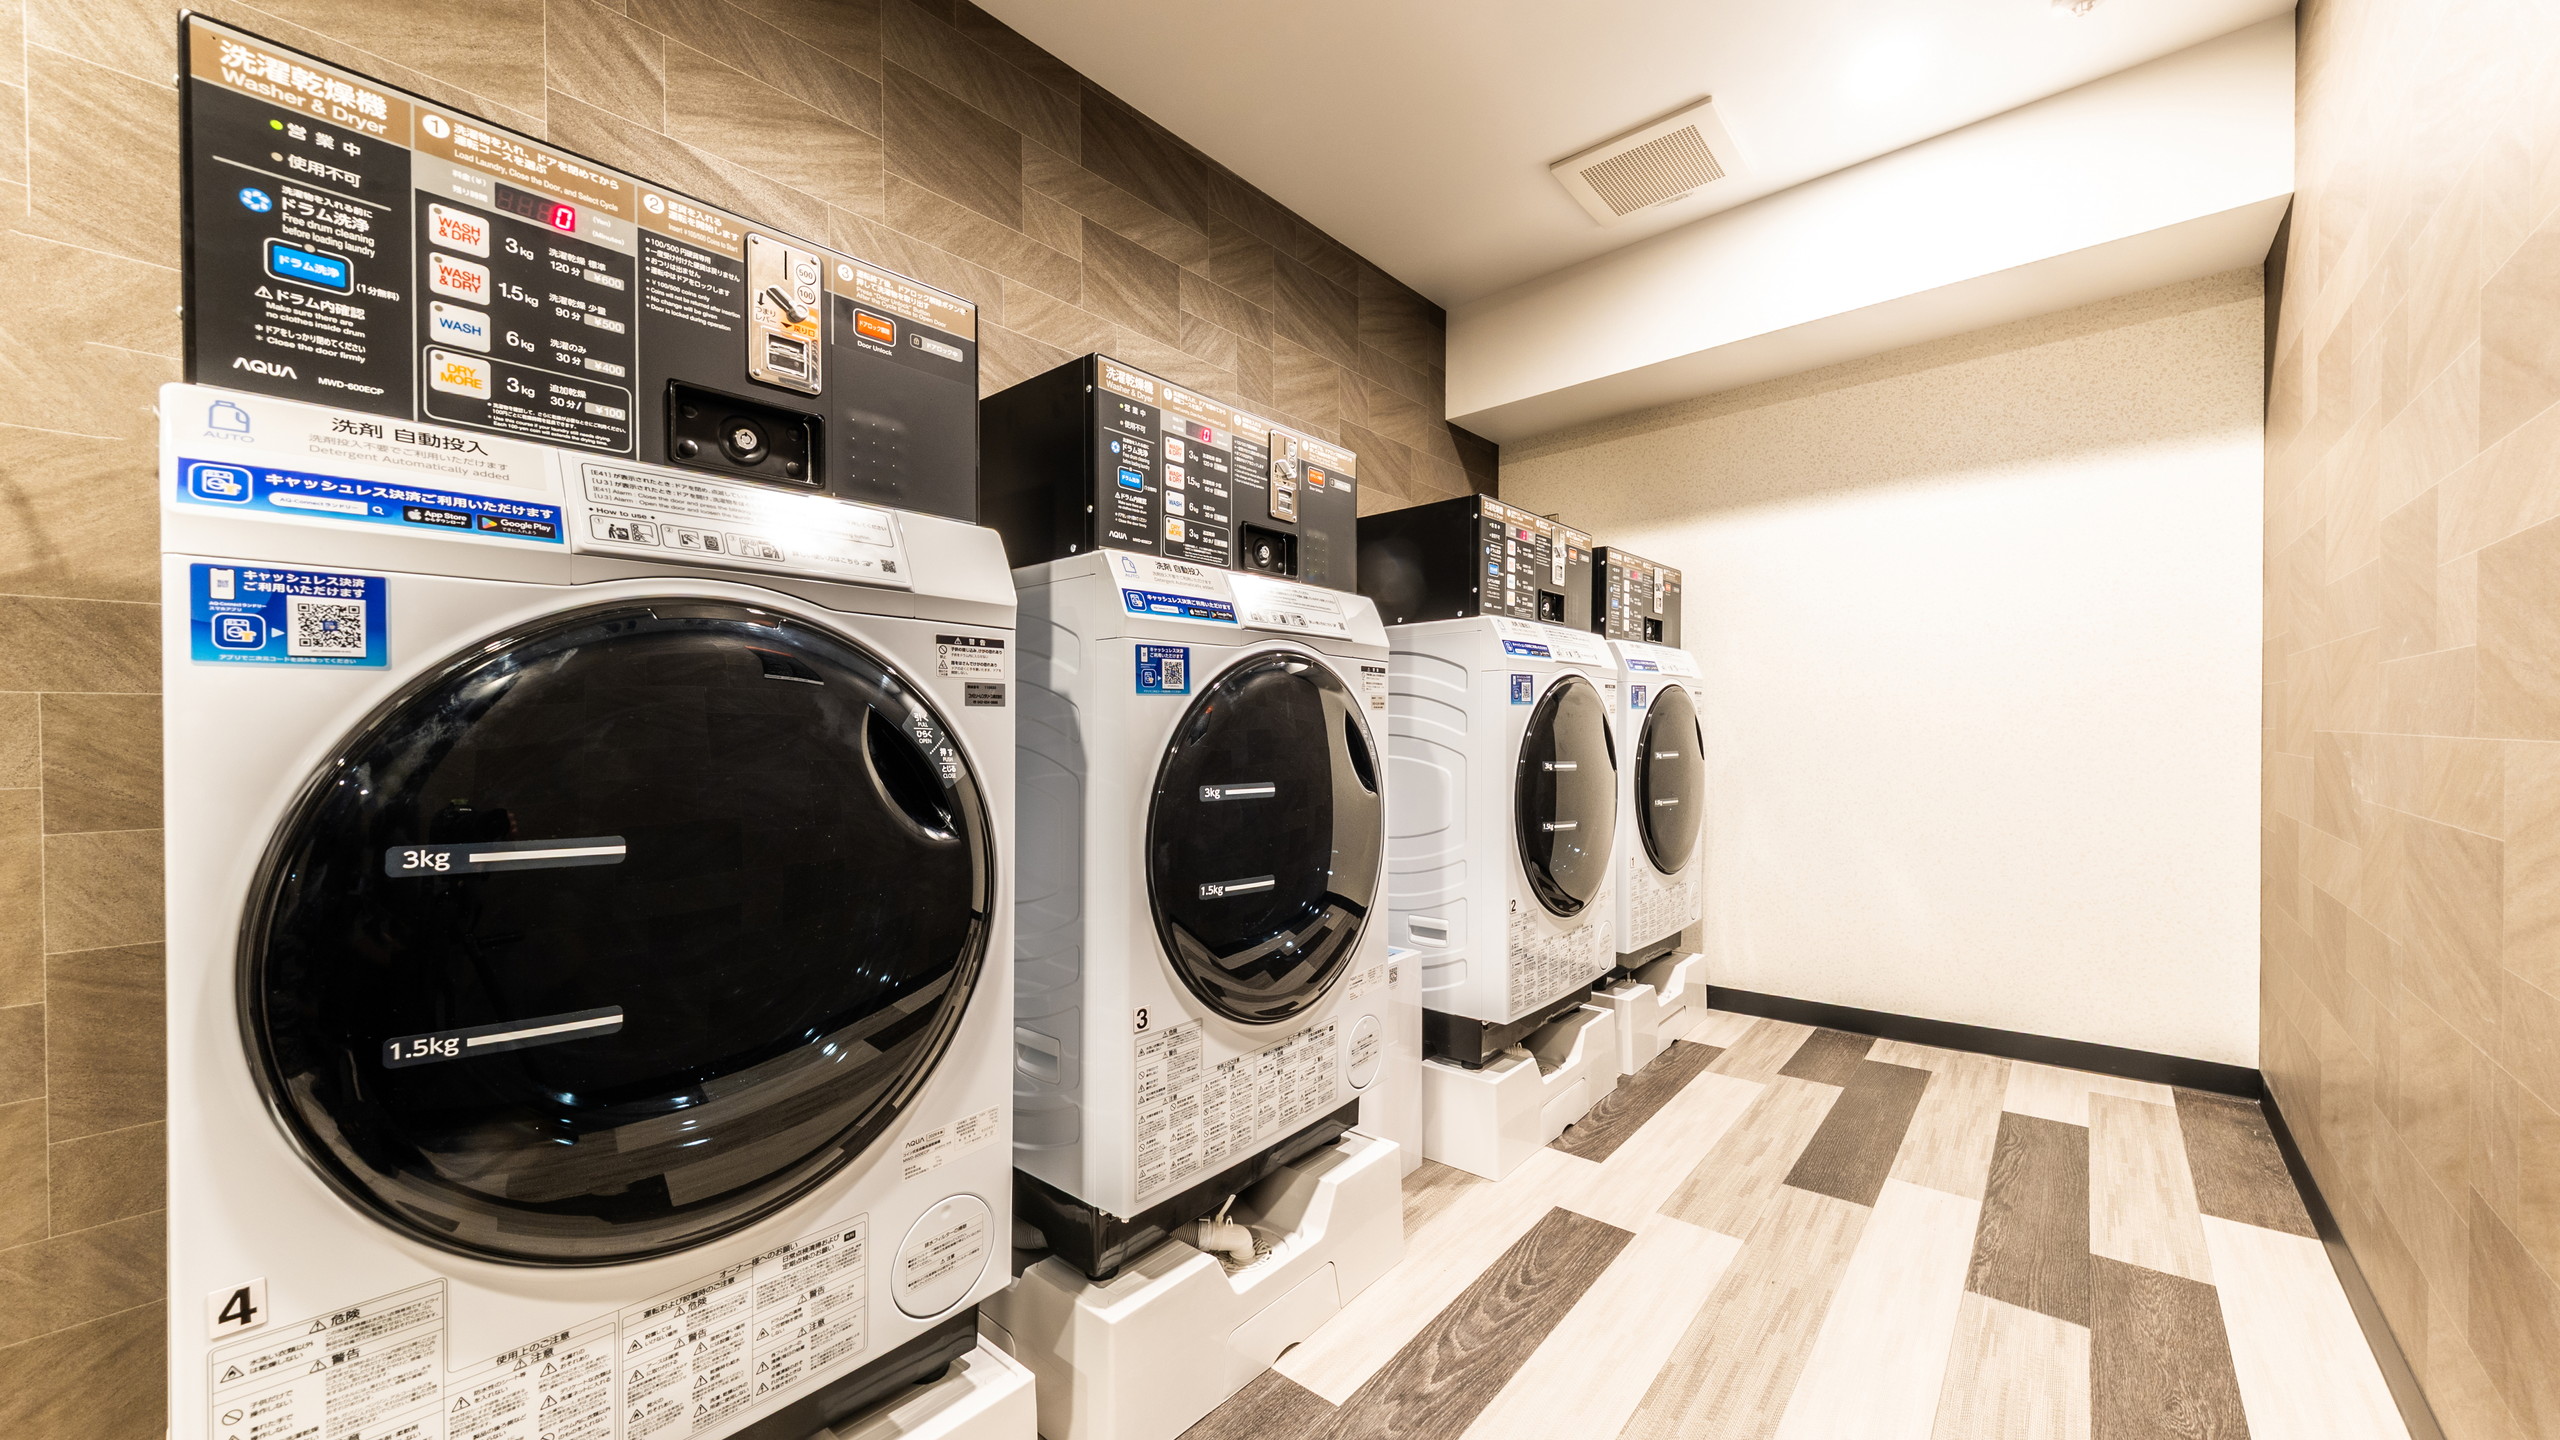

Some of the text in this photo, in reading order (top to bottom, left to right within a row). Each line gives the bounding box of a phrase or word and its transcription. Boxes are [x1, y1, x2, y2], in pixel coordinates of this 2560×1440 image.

[220, 40, 388, 120] 洗濯乾燥機
[221, 67, 388, 134] Washer & Dryer
[287, 122, 361, 157] 営業中
[453, 134, 548, 175] 運転コースを選ぶ
[287, 154, 361, 188] 使用不可
[454, 149, 619, 212] Load Laundry, Close the Door, and Select Cycle
[281, 185, 373, 218] 洗濯物を入れる前に
[282, 197, 370, 232] ドラム洗浄
[555, 207, 573, 230] 0
[667, 200, 722, 227] 硬貨を入れる
[282, 212, 375, 247] Free drum cleaning
[438, 216, 481, 237] WASH
[438, 226, 481, 246] & DRY
[668, 210, 740, 241] 運転を開始します
[282, 224, 375, 258] before loading laundry
[651, 238, 679, 253] 100/500
[279, 254, 340, 278] ドラム洗浄
[438, 264, 481, 285] WASH
[651, 258, 701, 279] おつりは出ません
[438, 275, 481, 294] & DRY
[593, 273, 622, 289] ¥600
[266, 301, 354, 328] Make sure there are
[276, 289, 366, 320] ドラム内確認
[651, 295, 660, 303] No
[661, 299, 683, 310] change
[683, 305, 693, 313] will
[702, 310, 718, 320] given
[755, 306, 777, 317] つまり
[266, 311, 366, 338] no clothes inside drum
[439, 317, 482, 336] WASH
[594, 317, 622, 333] ¥500
[755, 313, 777, 324] レバー
[266, 336, 366, 364] Close the door firmly
[550, 338, 587, 355] 洗濯のみ
[857, 340, 893, 356] Door Unlock
[233, 357, 297, 379] AQUA
[446, 363, 476, 377] DRY
[594, 360, 622, 376] ¥400
[318, 377, 384, 396] MWD-600ECP
[440, 371, 483, 390] MORE
[1105, 365, 1153, 395] 洗濯乾燥機
[1105, 379, 1154, 403] Washer & Dryer
[594, 404, 622, 419] ¥100
[202, 430, 255, 443] AUTO
[331, 416, 489, 457] 洗剤 自動投入
[308, 444, 510, 482] Detergent Automatically added
[264, 473, 555, 520] キャッシュレス決済ご利用いただけます
[424, 511, 467, 522] App Store
[596, 508, 617, 516] How
[500, 519, 551, 533] Google Play
[1108, 530, 1128, 541] AQUA
[243, 570, 366, 588] キャッシュレス決済
[243, 581, 366, 598] ご利用いただけます
[913, 713, 929, 723] 引く
[916, 730, 933, 739] ひらく
[1204, 788, 1220, 799] 3kg
[402, 850, 450, 872] 3kg
[1200, 885, 1223, 896] 1.5kg
[1511, 899, 1516, 912] 2
[1137, 1008, 1148, 1029] 3
[389, 1037, 460, 1061] 1.5kg
[905, 1137, 925, 1149] AQUA
[720, 1243, 798, 1278] オーナー様へのお願い
[218, 1286, 258, 1326] 4
[331, 1308, 361, 1327] 危険
[332, 1348, 360, 1366] 警告
[496, 1331, 570, 1366] 使用上のご注意
[530, 1347, 555, 1364] 注意
